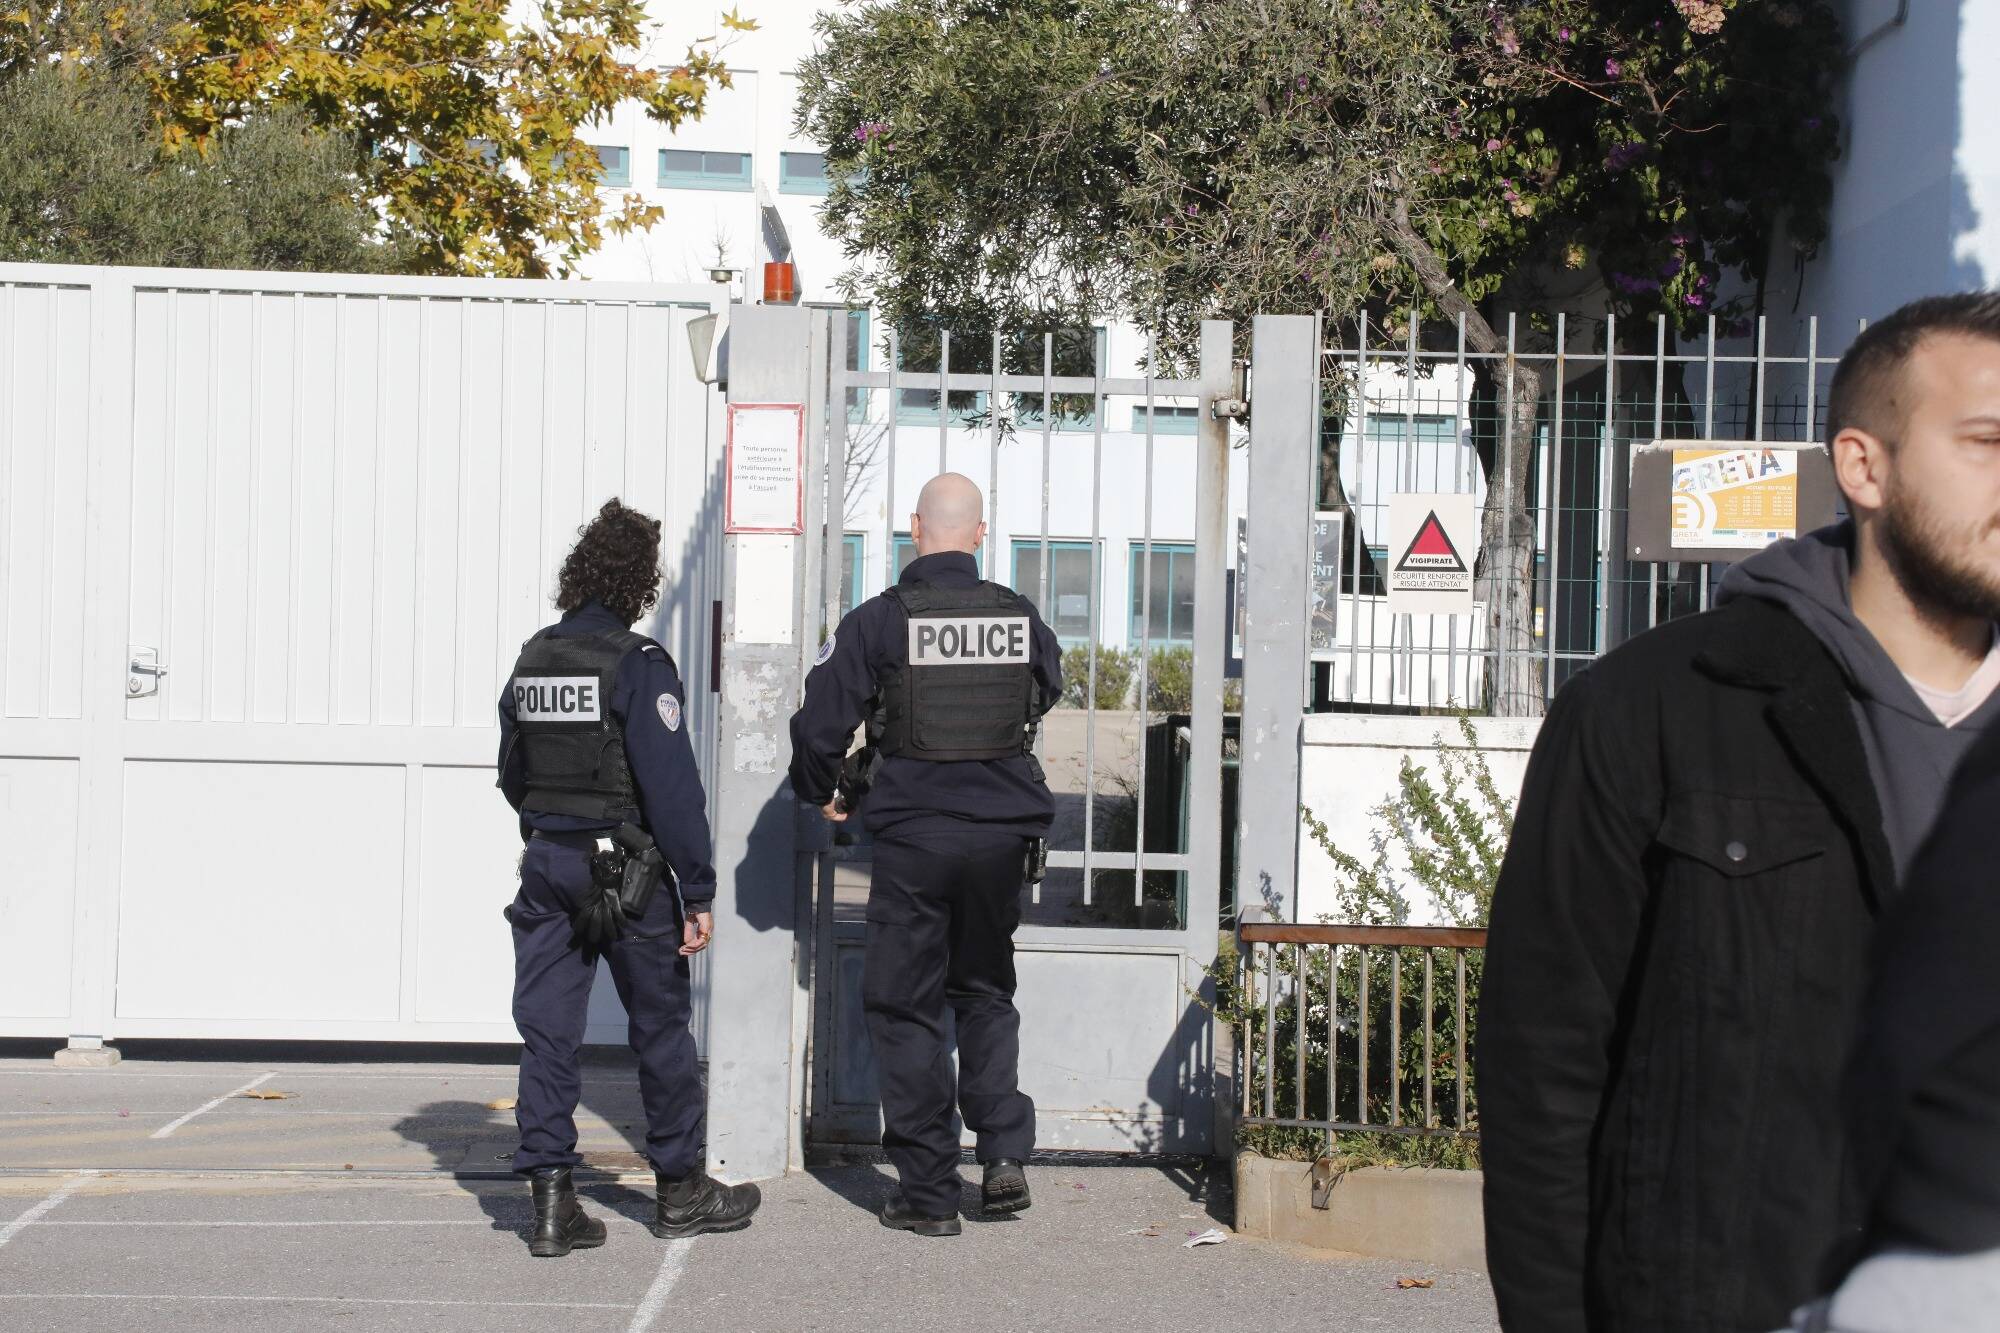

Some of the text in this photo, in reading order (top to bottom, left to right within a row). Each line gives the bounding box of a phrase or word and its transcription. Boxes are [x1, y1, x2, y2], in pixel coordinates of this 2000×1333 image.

[1672, 448, 1783, 492] GRETA
[1409, 557, 1453, 565] VIGIPIRATE
[1400, 580, 1461, 588] RISQUE ATTENTAT
[917, 623, 1023, 659] POLICE
[516, 684, 594, 714] POLICE
